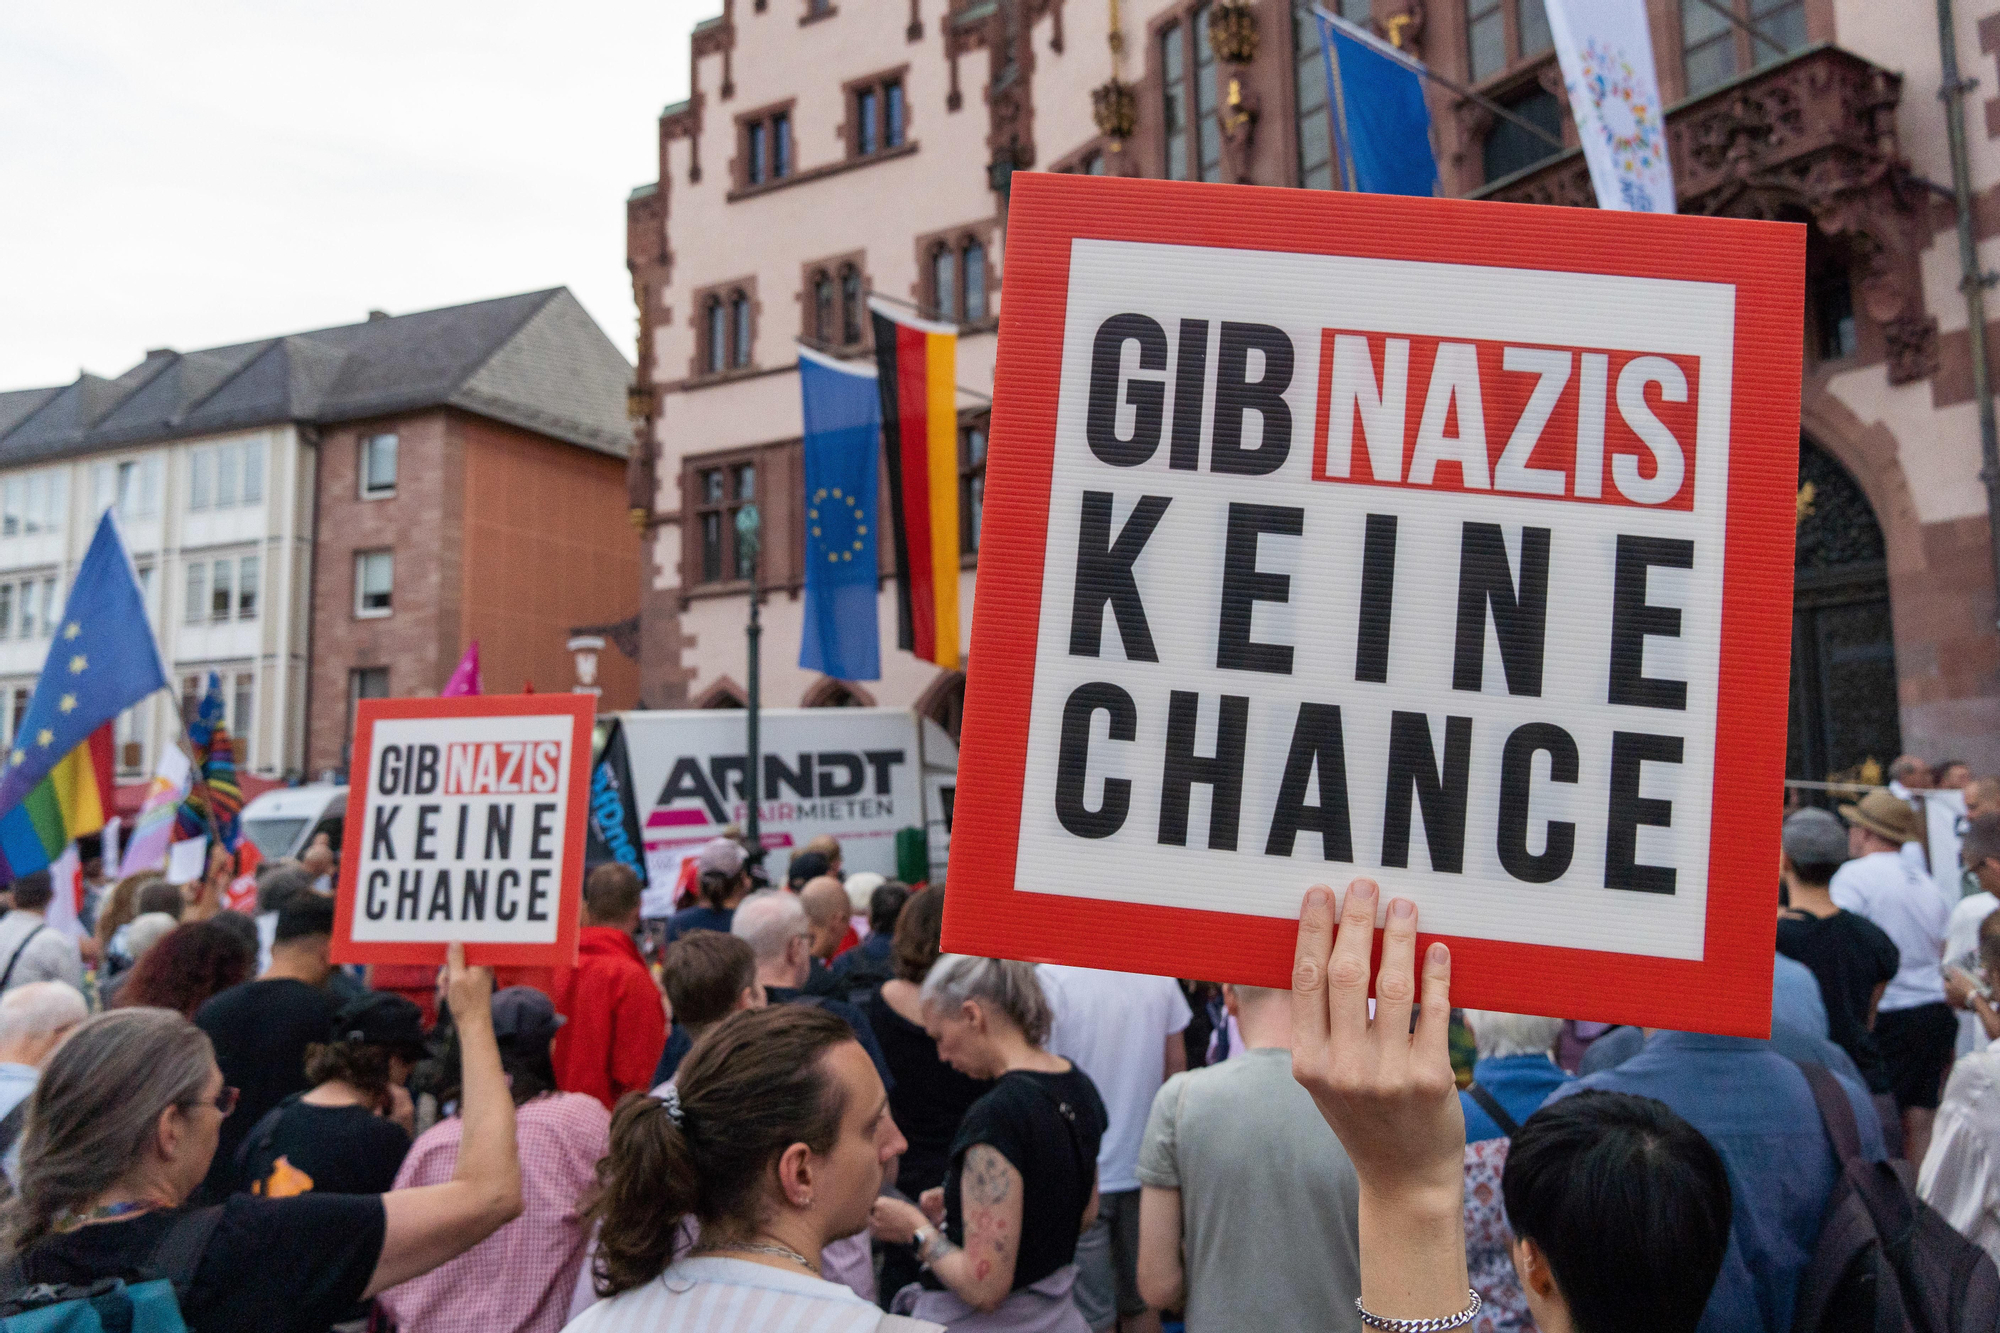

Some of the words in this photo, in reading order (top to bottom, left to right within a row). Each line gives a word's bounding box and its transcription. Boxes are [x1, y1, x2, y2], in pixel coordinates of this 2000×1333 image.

[1086, 312, 1295, 476] GIB
[1325, 334, 1690, 506] NAZIS
[1068, 490, 1695, 711] KEINE
[378, 744, 440, 796] GIB
[449, 742, 558, 793] NAZIS
[656, 749, 906, 825] ARNDT
[1054, 681, 1685, 896] CHANCE
[371, 803, 556, 861] KEINE
[365, 868, 551, 922] CHANCE
